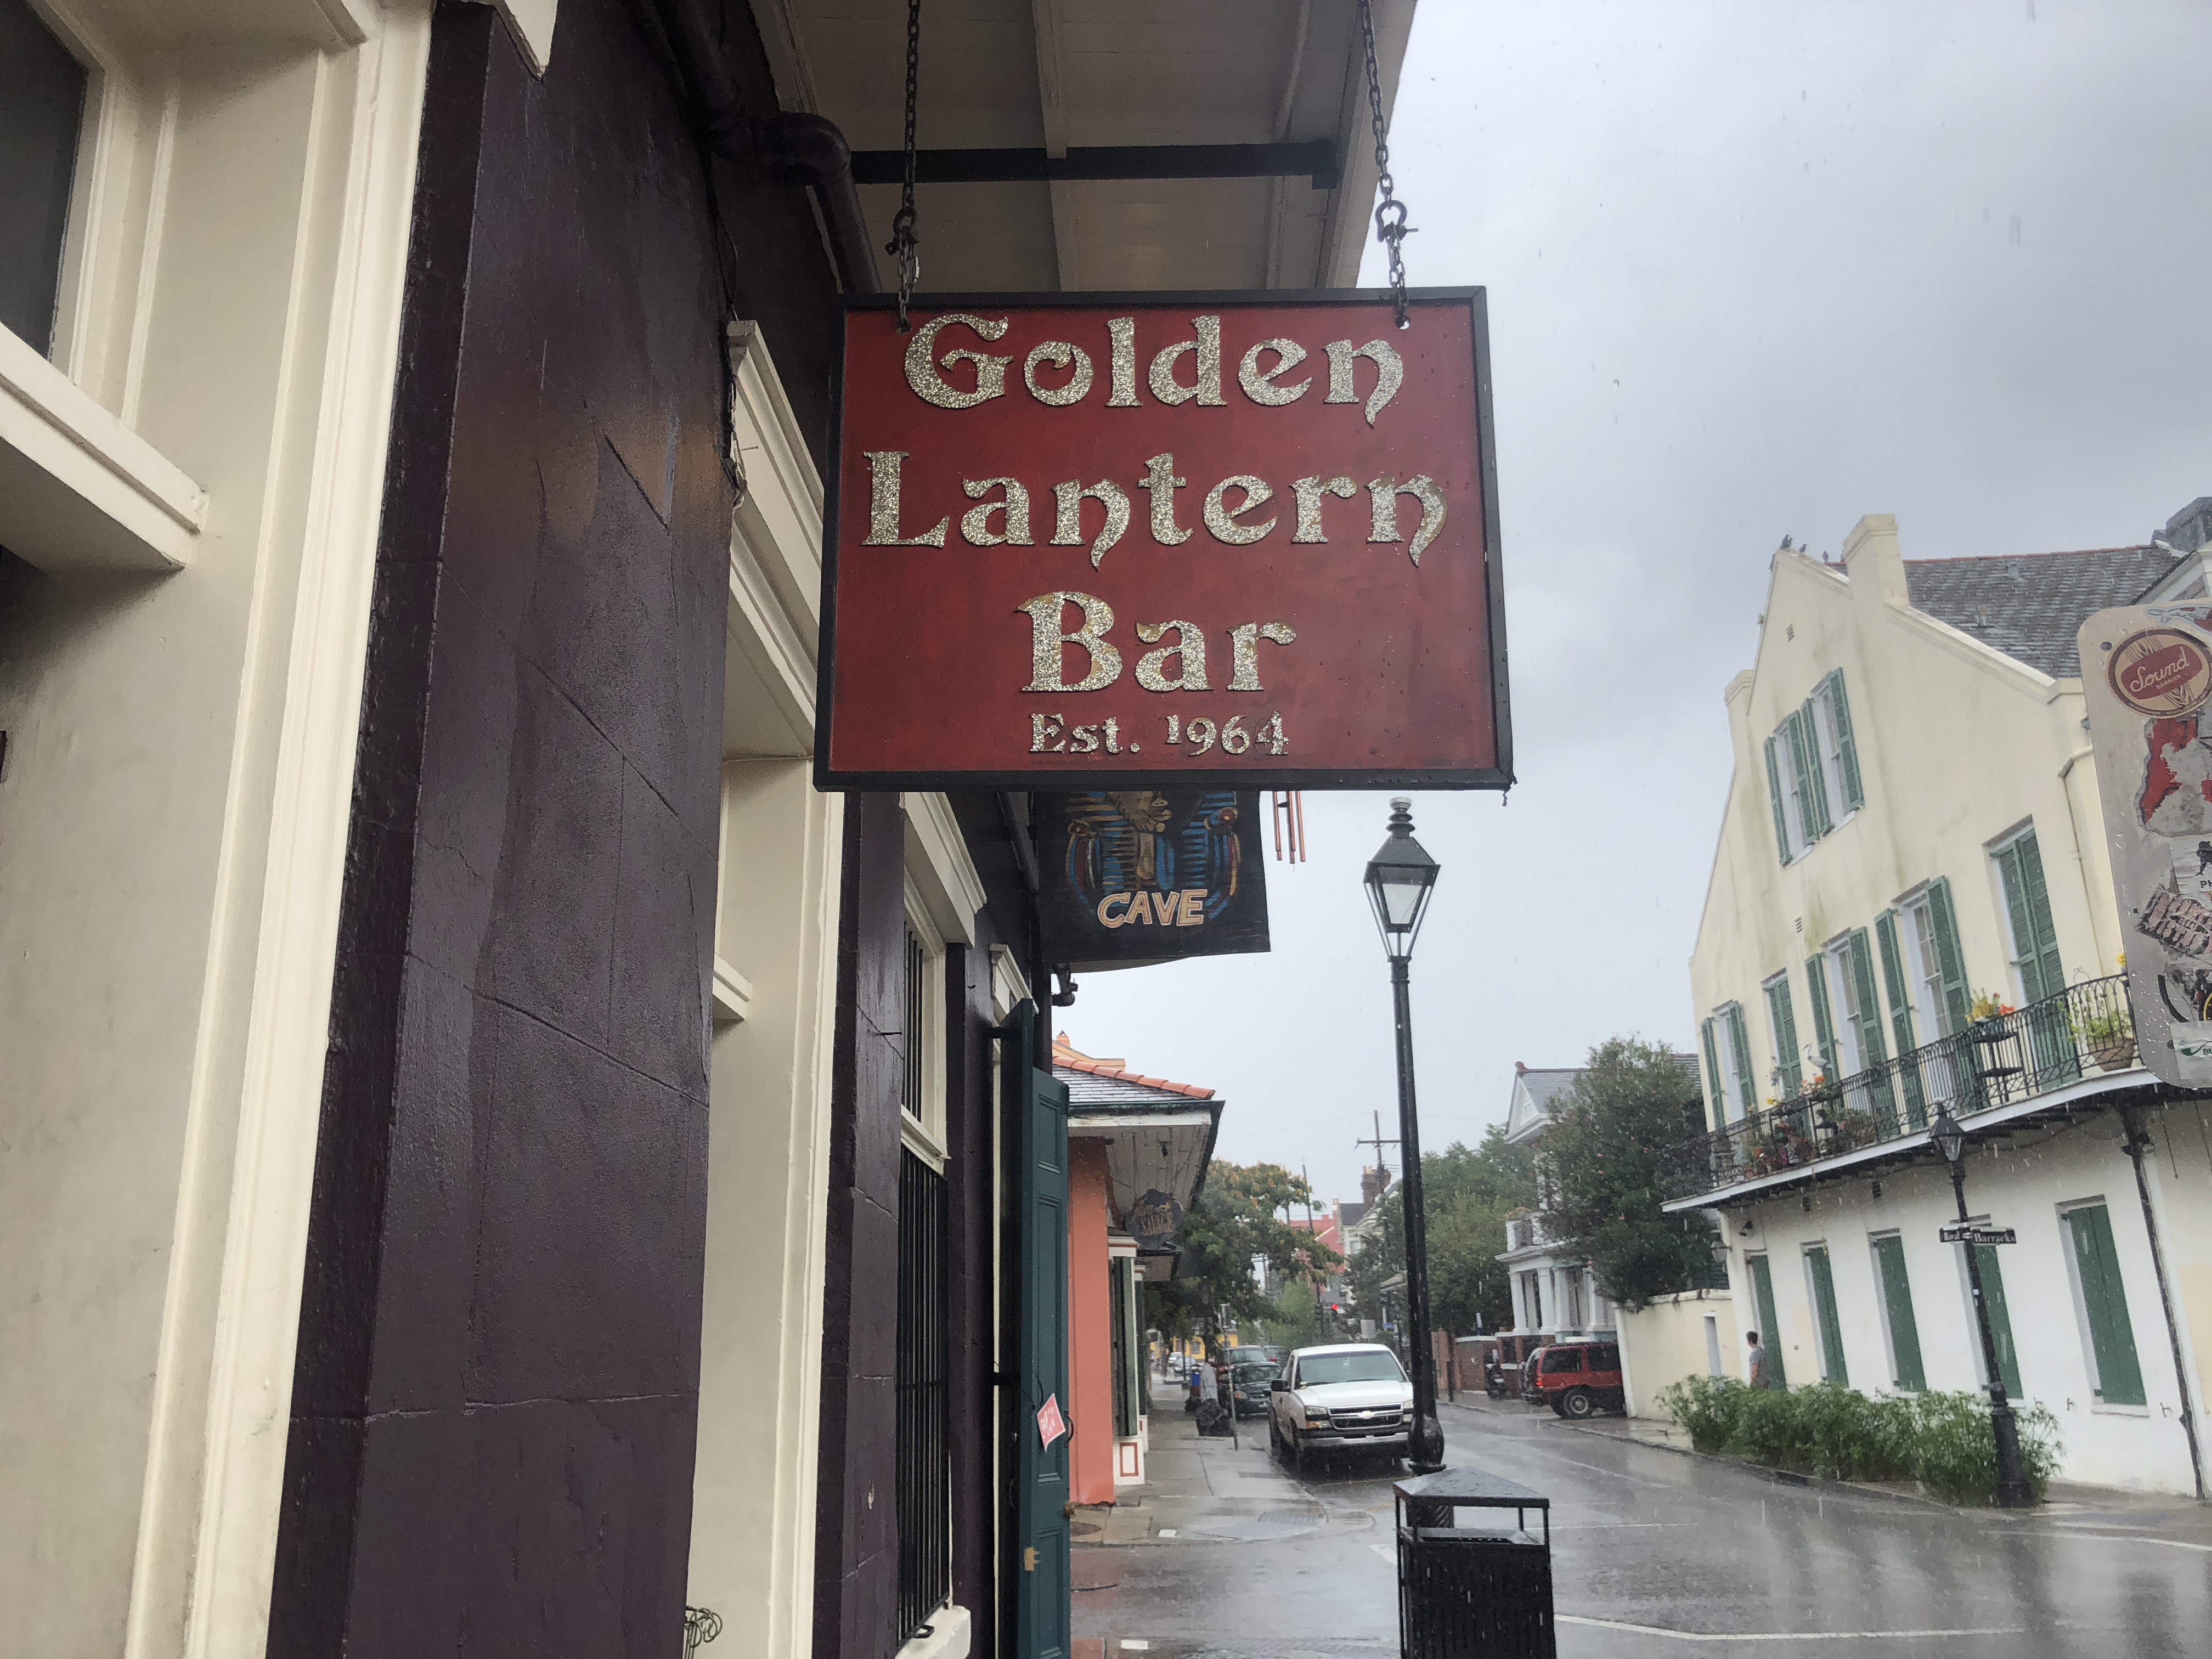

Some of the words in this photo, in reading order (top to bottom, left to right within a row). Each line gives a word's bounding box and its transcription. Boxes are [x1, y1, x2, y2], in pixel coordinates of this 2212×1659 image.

[904, 313, 1404, 428] Golden
[860, 451, 1448, 569] Lantern
[1014, 590, 1297, 692] Bar
[2130, 646, 2190, 692] Sound
[2155, 674, 2182, 690] BARRIER
[1028, 713, 1141, 755] Est.
[1166, 710, 1289, 757] 1964
[1098, 889, 1207, 928] CAVE
